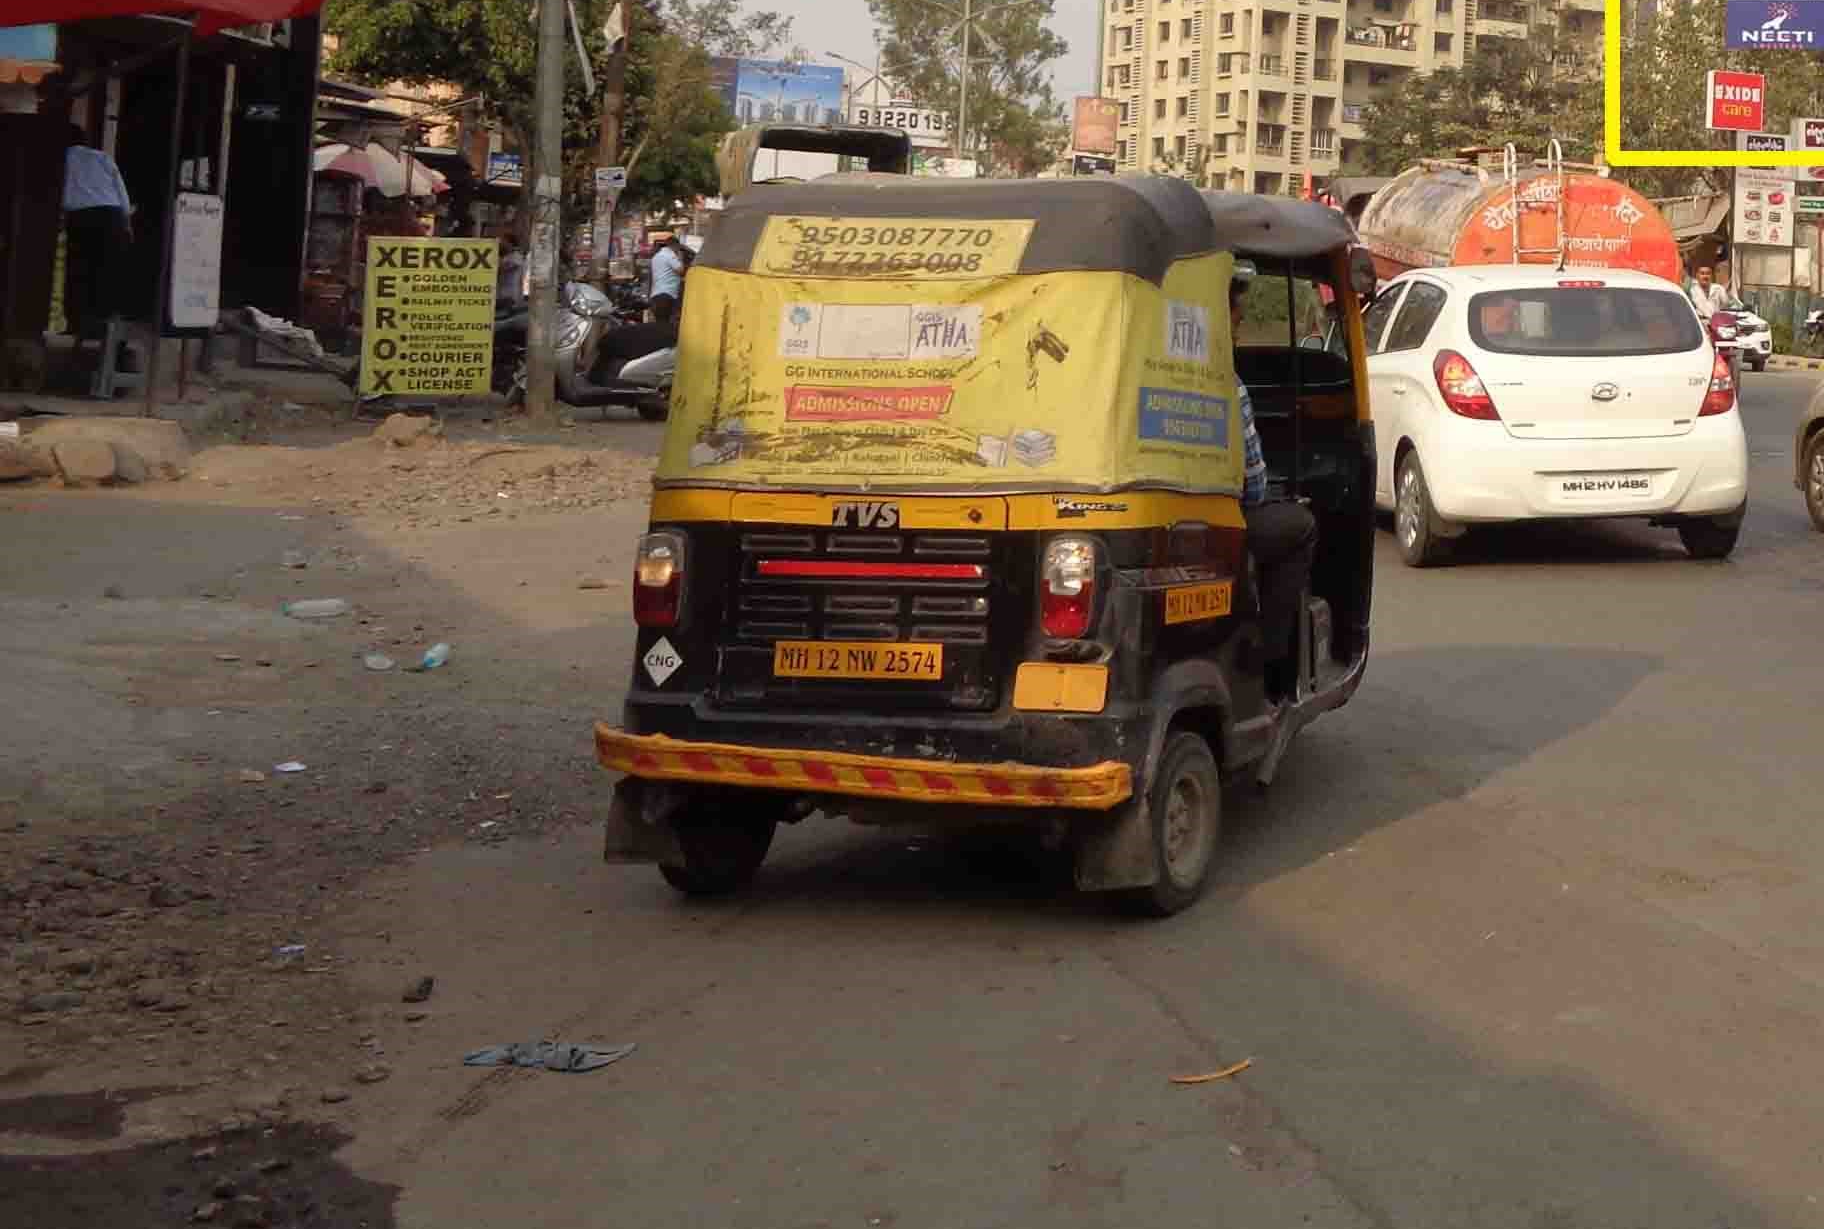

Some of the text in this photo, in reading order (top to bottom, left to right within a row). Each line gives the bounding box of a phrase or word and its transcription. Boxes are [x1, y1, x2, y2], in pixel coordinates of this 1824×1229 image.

[1741, 31, 1814, 43] NEETI
[1715, 84, 1761, 103] EXIDE
[1722, 103, 1752, 116] care
[801, 226, 994, 247] 9503087770
[375, 246, 493, 270] XEROX
[412, 274, 468, 283] GOLDEN
[411, 285, 491, 293] EMBOSSING
[409, 312, 453, 322] POLICE
[409, 322, 492, 332] VERIFICATION
[408, 352, 484, 363] COURIER
[407, 367, 487, 378] SHOP ACT
[785, 365, 807, 377] GG
[808, 366, 905, 379] INTERNATIONAL
[407, 379, 473, 390] LICENSE
[799, 394, 943, 412] ADMISSIONS OPEN
[1563, 479, 1649, 491] MH 12 HV 1486
[832, 502, 900, 528] TVS
[647, 654, 675, 669] CNG
[779, 648, 936, 674] MH 12 NW 2574
